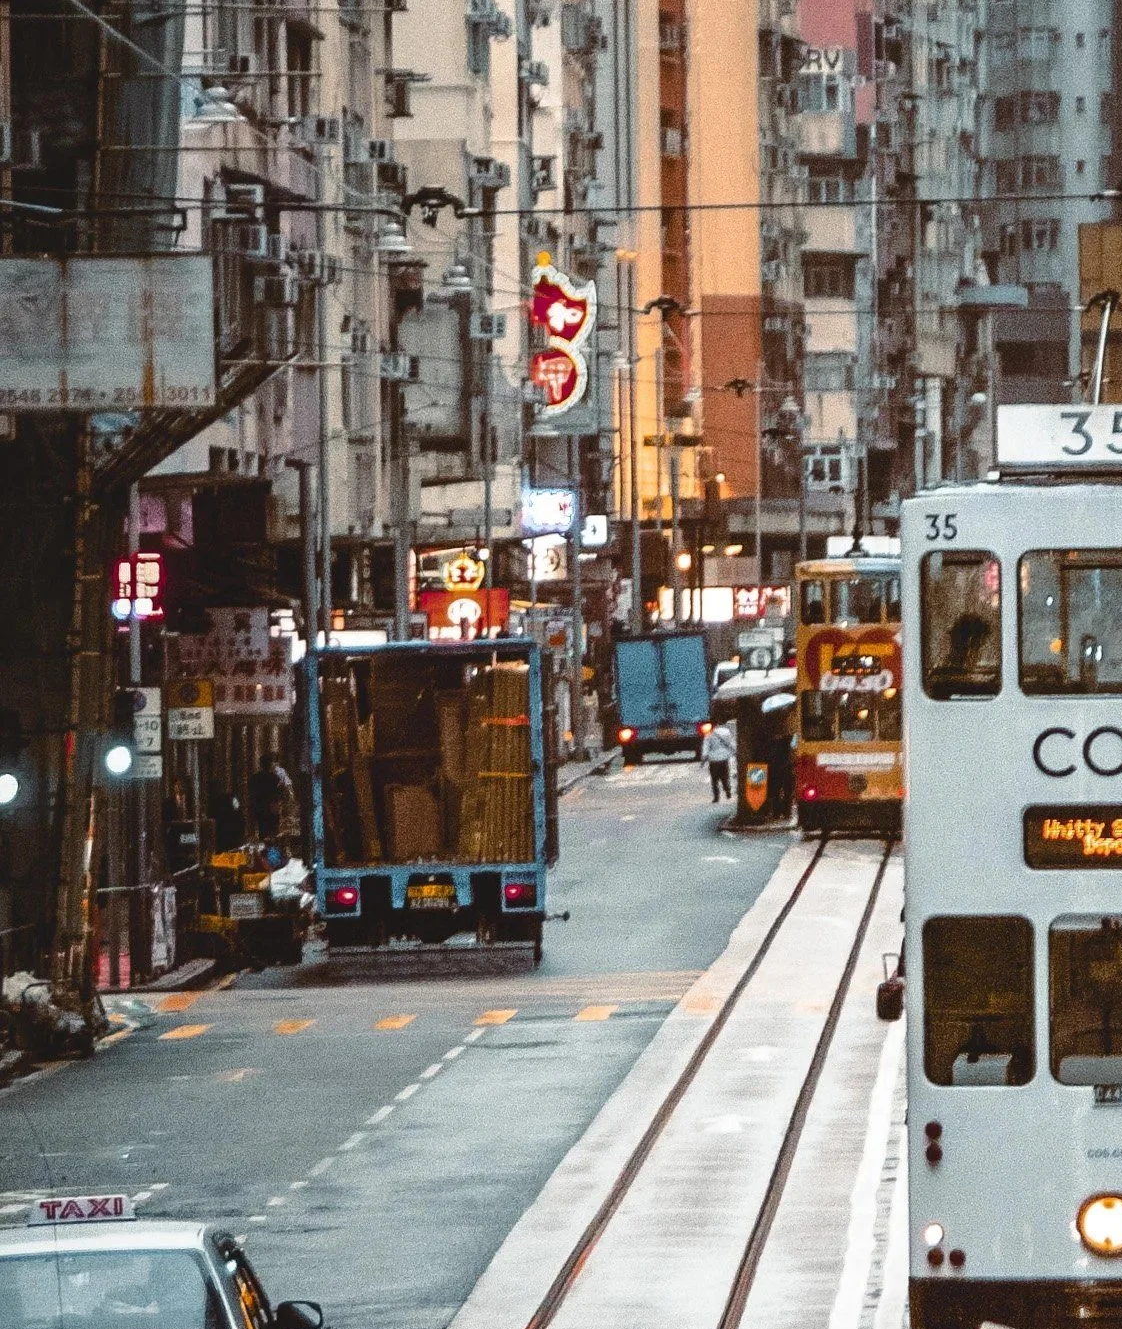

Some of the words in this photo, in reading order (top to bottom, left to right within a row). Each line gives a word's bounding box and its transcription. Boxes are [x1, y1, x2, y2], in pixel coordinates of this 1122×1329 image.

[925, 513, 958, 541] 35
[1042, 818, 1106, 840] Whitty
[40, 1197, 123, 1219] TAXI
